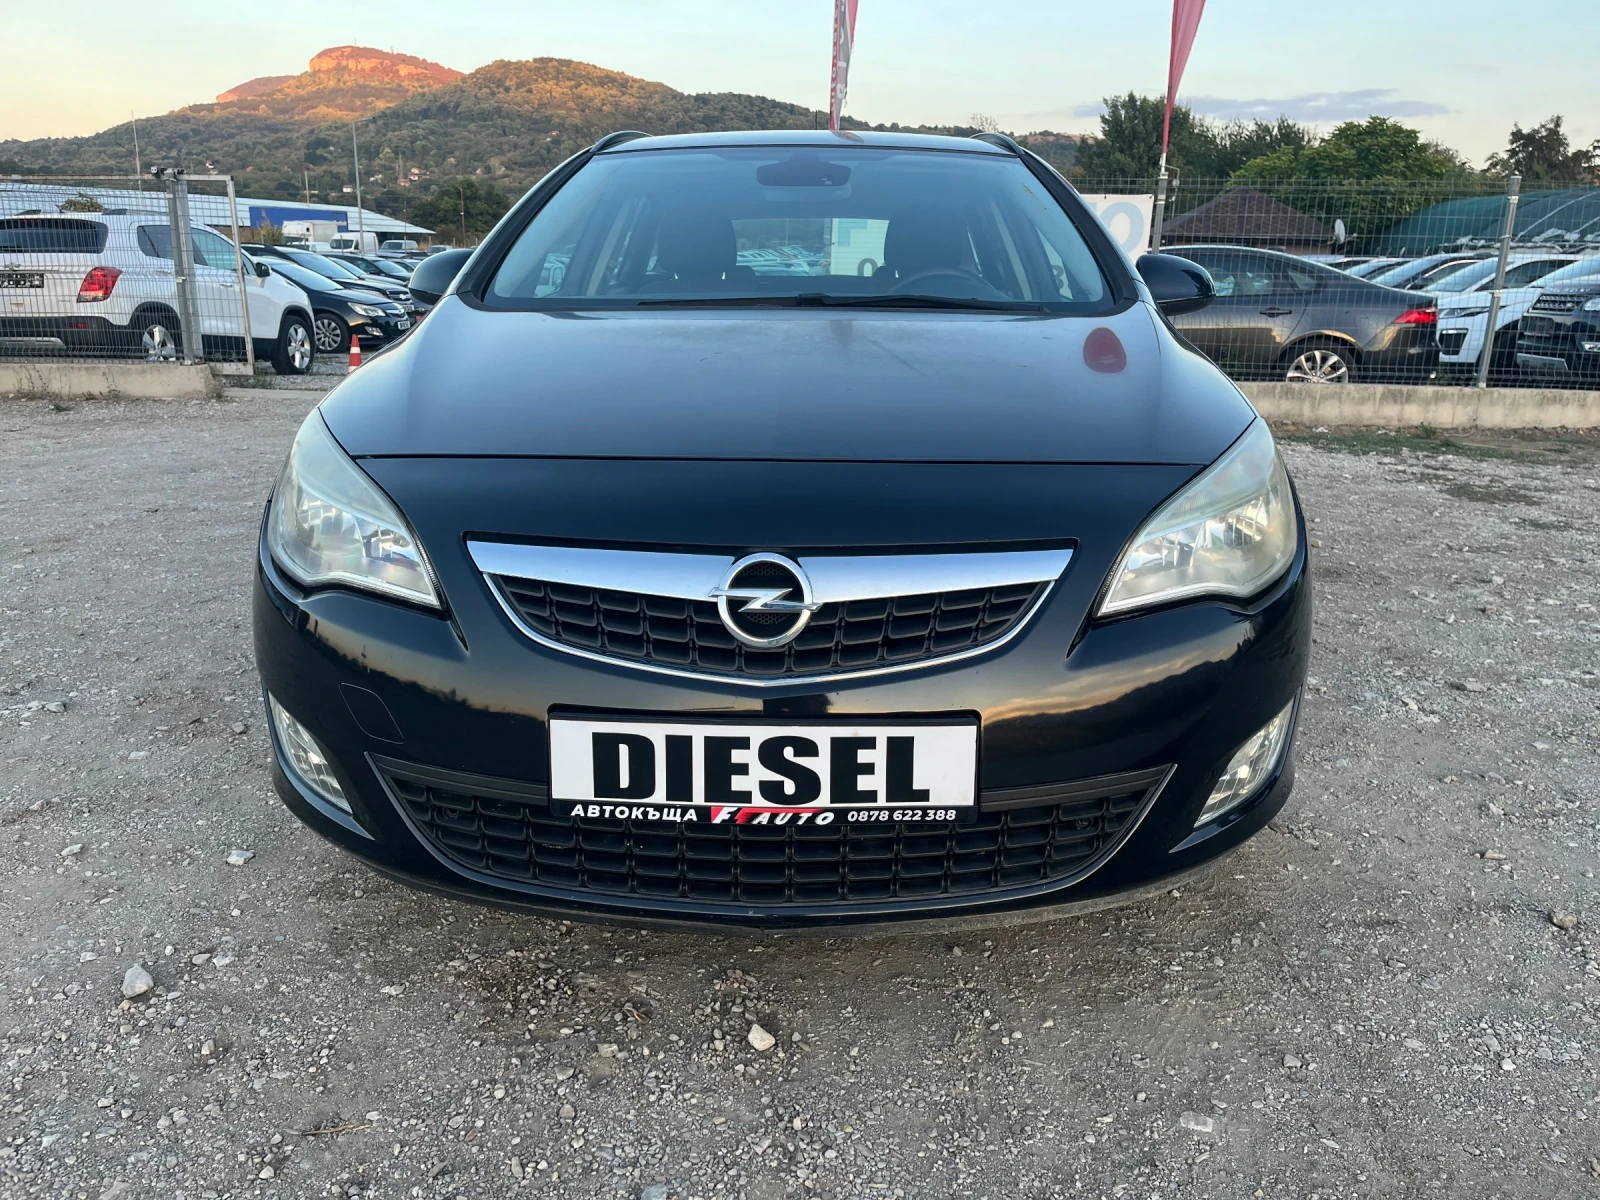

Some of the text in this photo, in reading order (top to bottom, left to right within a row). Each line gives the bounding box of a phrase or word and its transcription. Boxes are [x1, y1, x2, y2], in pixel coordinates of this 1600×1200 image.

[592, 732, 930, 806] DIESEL
[571, 804, 698, 822] АВТОКЪЩА
[751, 812, 835, 825] AUTO
[847, 809, 957, 822] 0878 622 388
